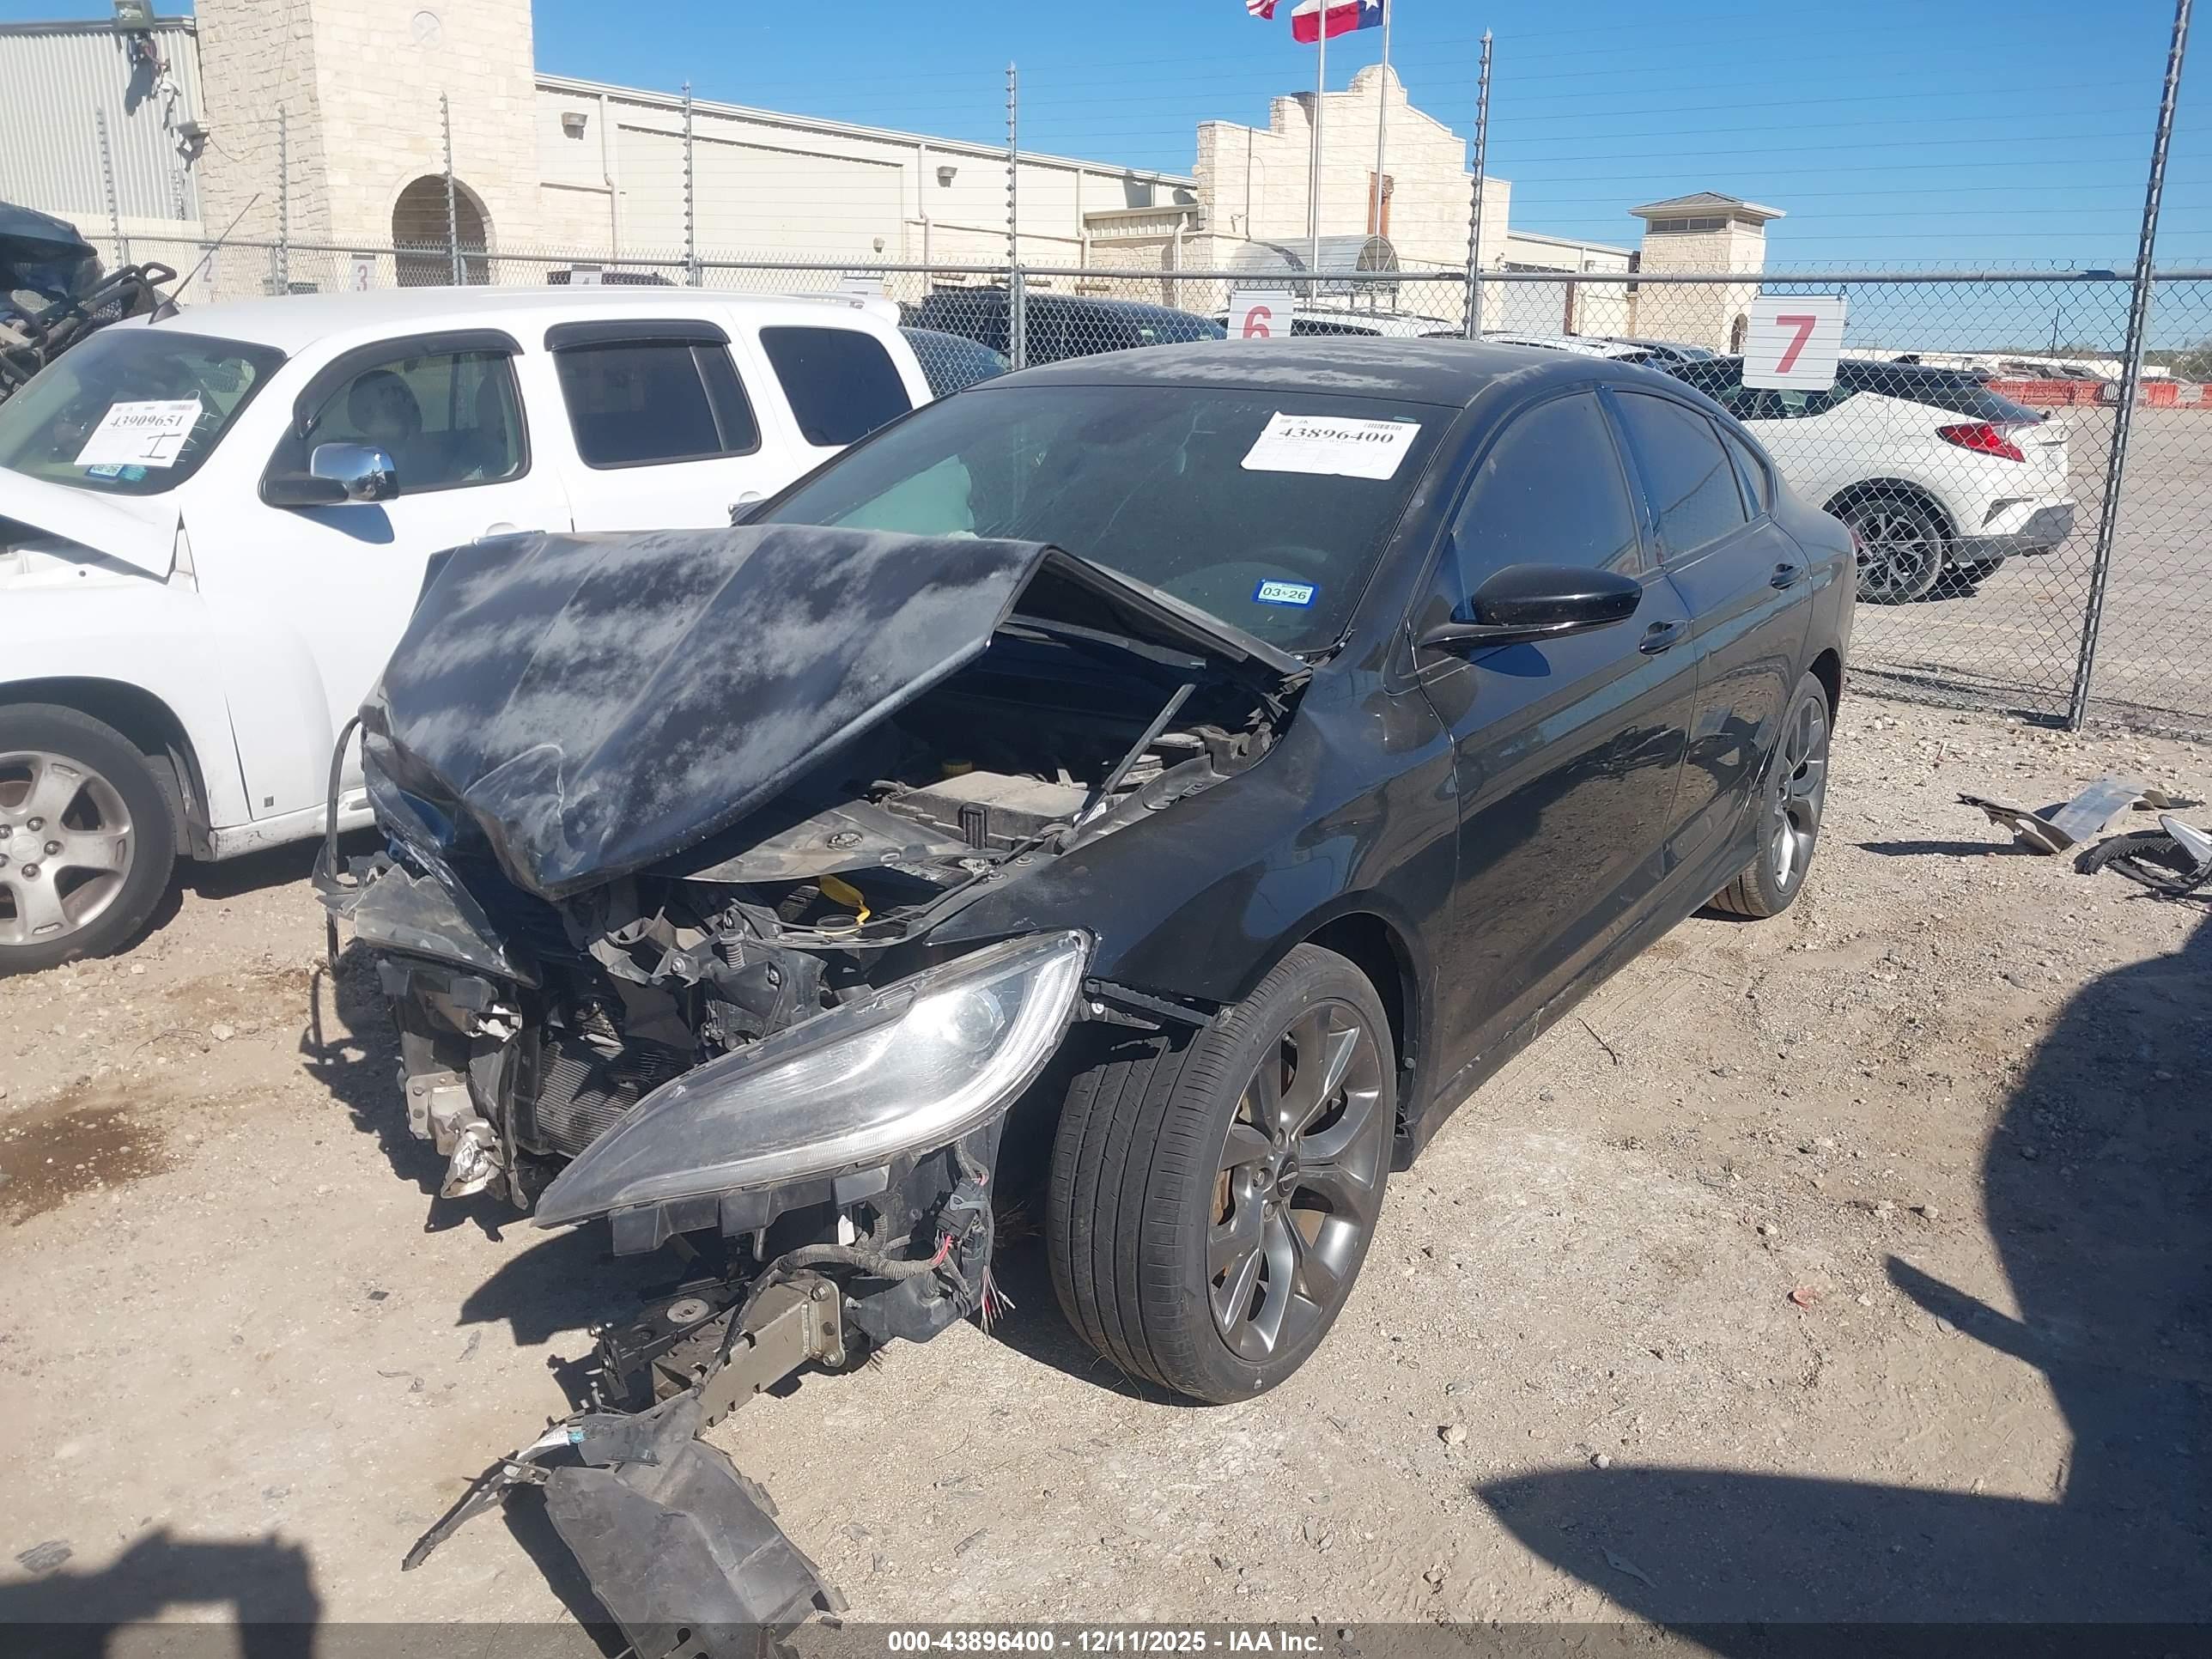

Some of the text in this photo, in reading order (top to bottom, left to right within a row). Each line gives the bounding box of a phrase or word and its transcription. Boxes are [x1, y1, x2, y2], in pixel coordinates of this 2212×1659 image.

[203, 257, 212, 283] 2
[356, 264, 368, 291] 3
[1243, 306, 1272, 338] 6
[1775, 315, 1816, 373] 7
[110, 415, 184, 427] 43909651
[1279, 428, 1394, 444] 43896400
